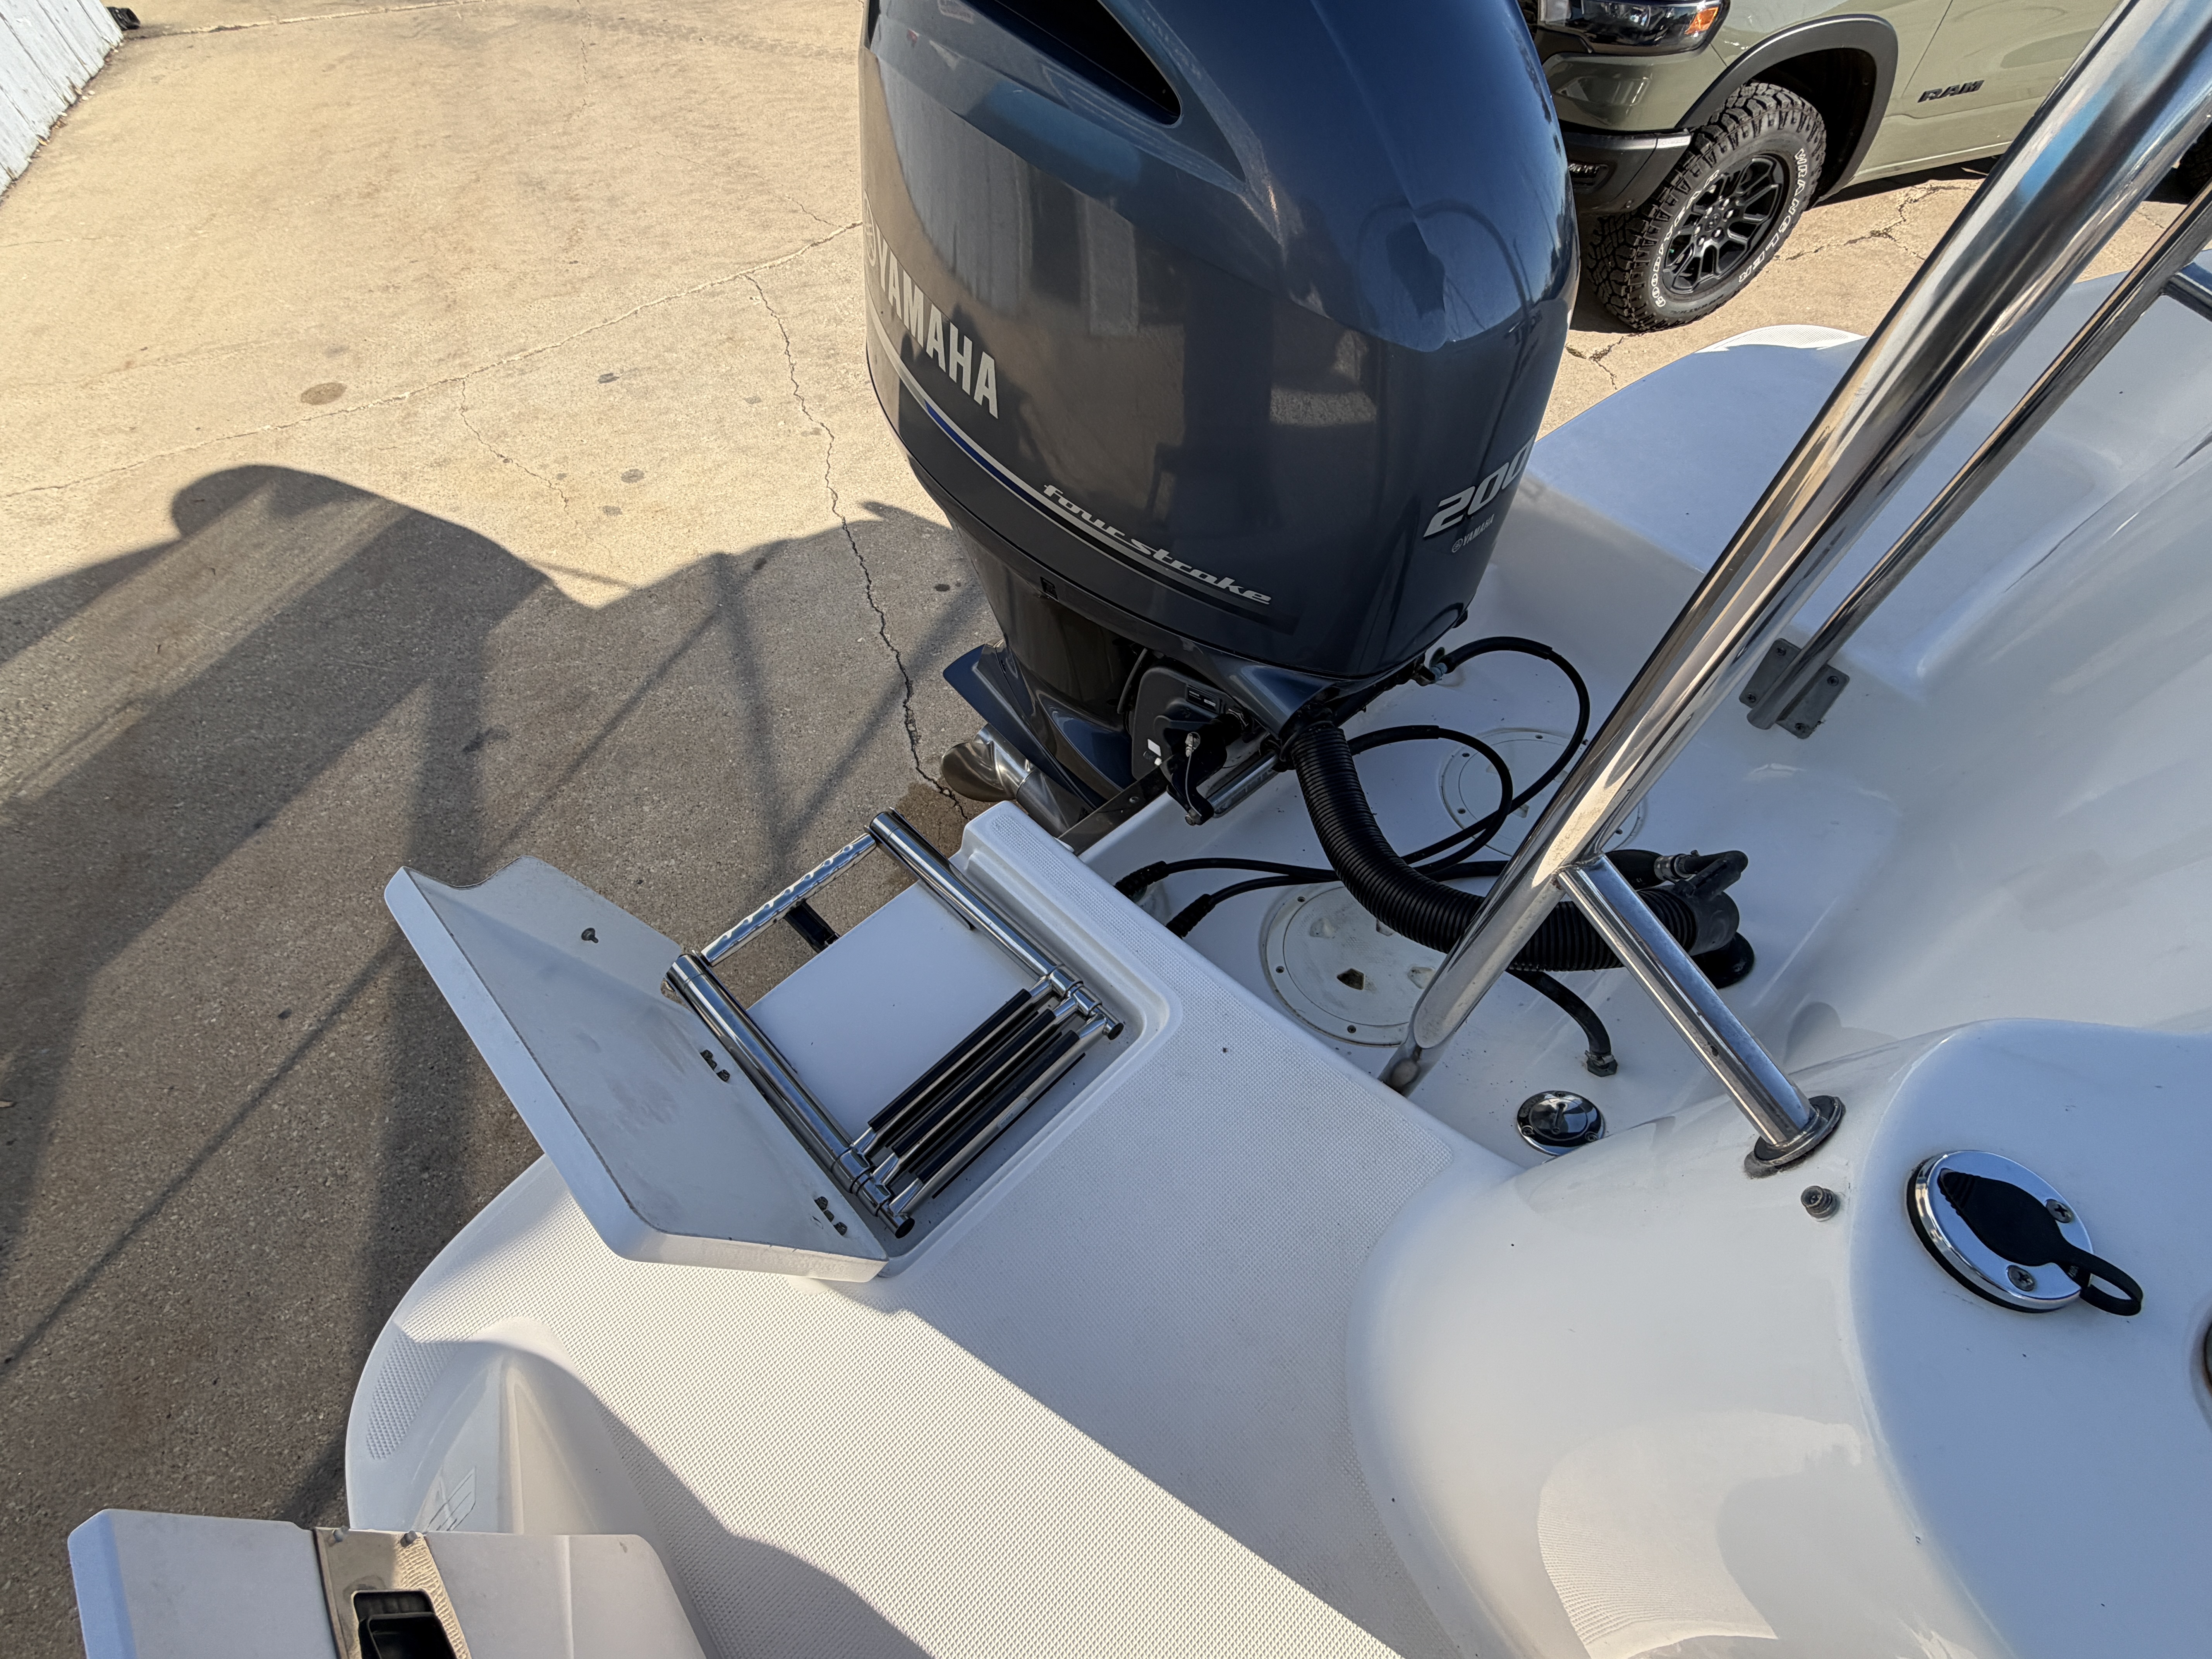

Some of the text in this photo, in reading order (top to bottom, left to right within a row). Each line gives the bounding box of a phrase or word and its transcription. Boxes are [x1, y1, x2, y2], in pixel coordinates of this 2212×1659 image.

[1917, 80, 1985, 103] RAM
[1738, 148, 1807, 282] WRANGLER
[876, 223, 998, 419] YAMAHA
[1423, 434, 1535, 538] 200
[1463, 514, 1495, 546] YAMAHA
